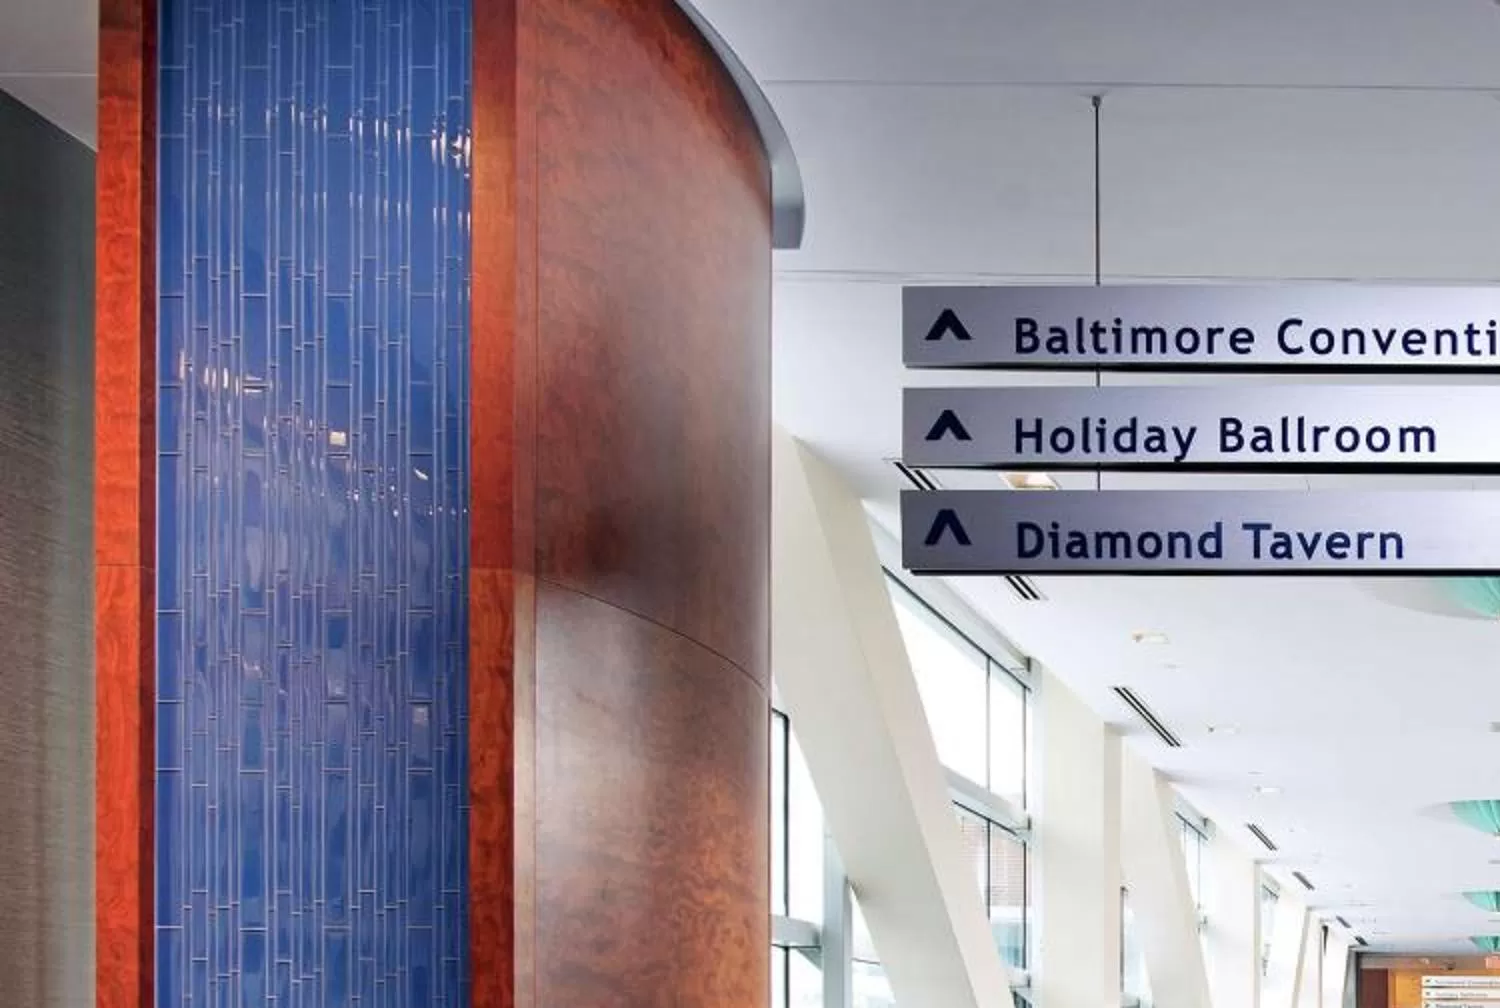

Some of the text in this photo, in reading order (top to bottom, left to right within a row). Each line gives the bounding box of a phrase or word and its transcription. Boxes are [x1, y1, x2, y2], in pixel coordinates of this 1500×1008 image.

[1015, 316, 1255, 356] Baltimore
[1015, 416, 1437, 461] Holiday Ballroom
[1017, 521, 1404, 561] Diamond Tavern
